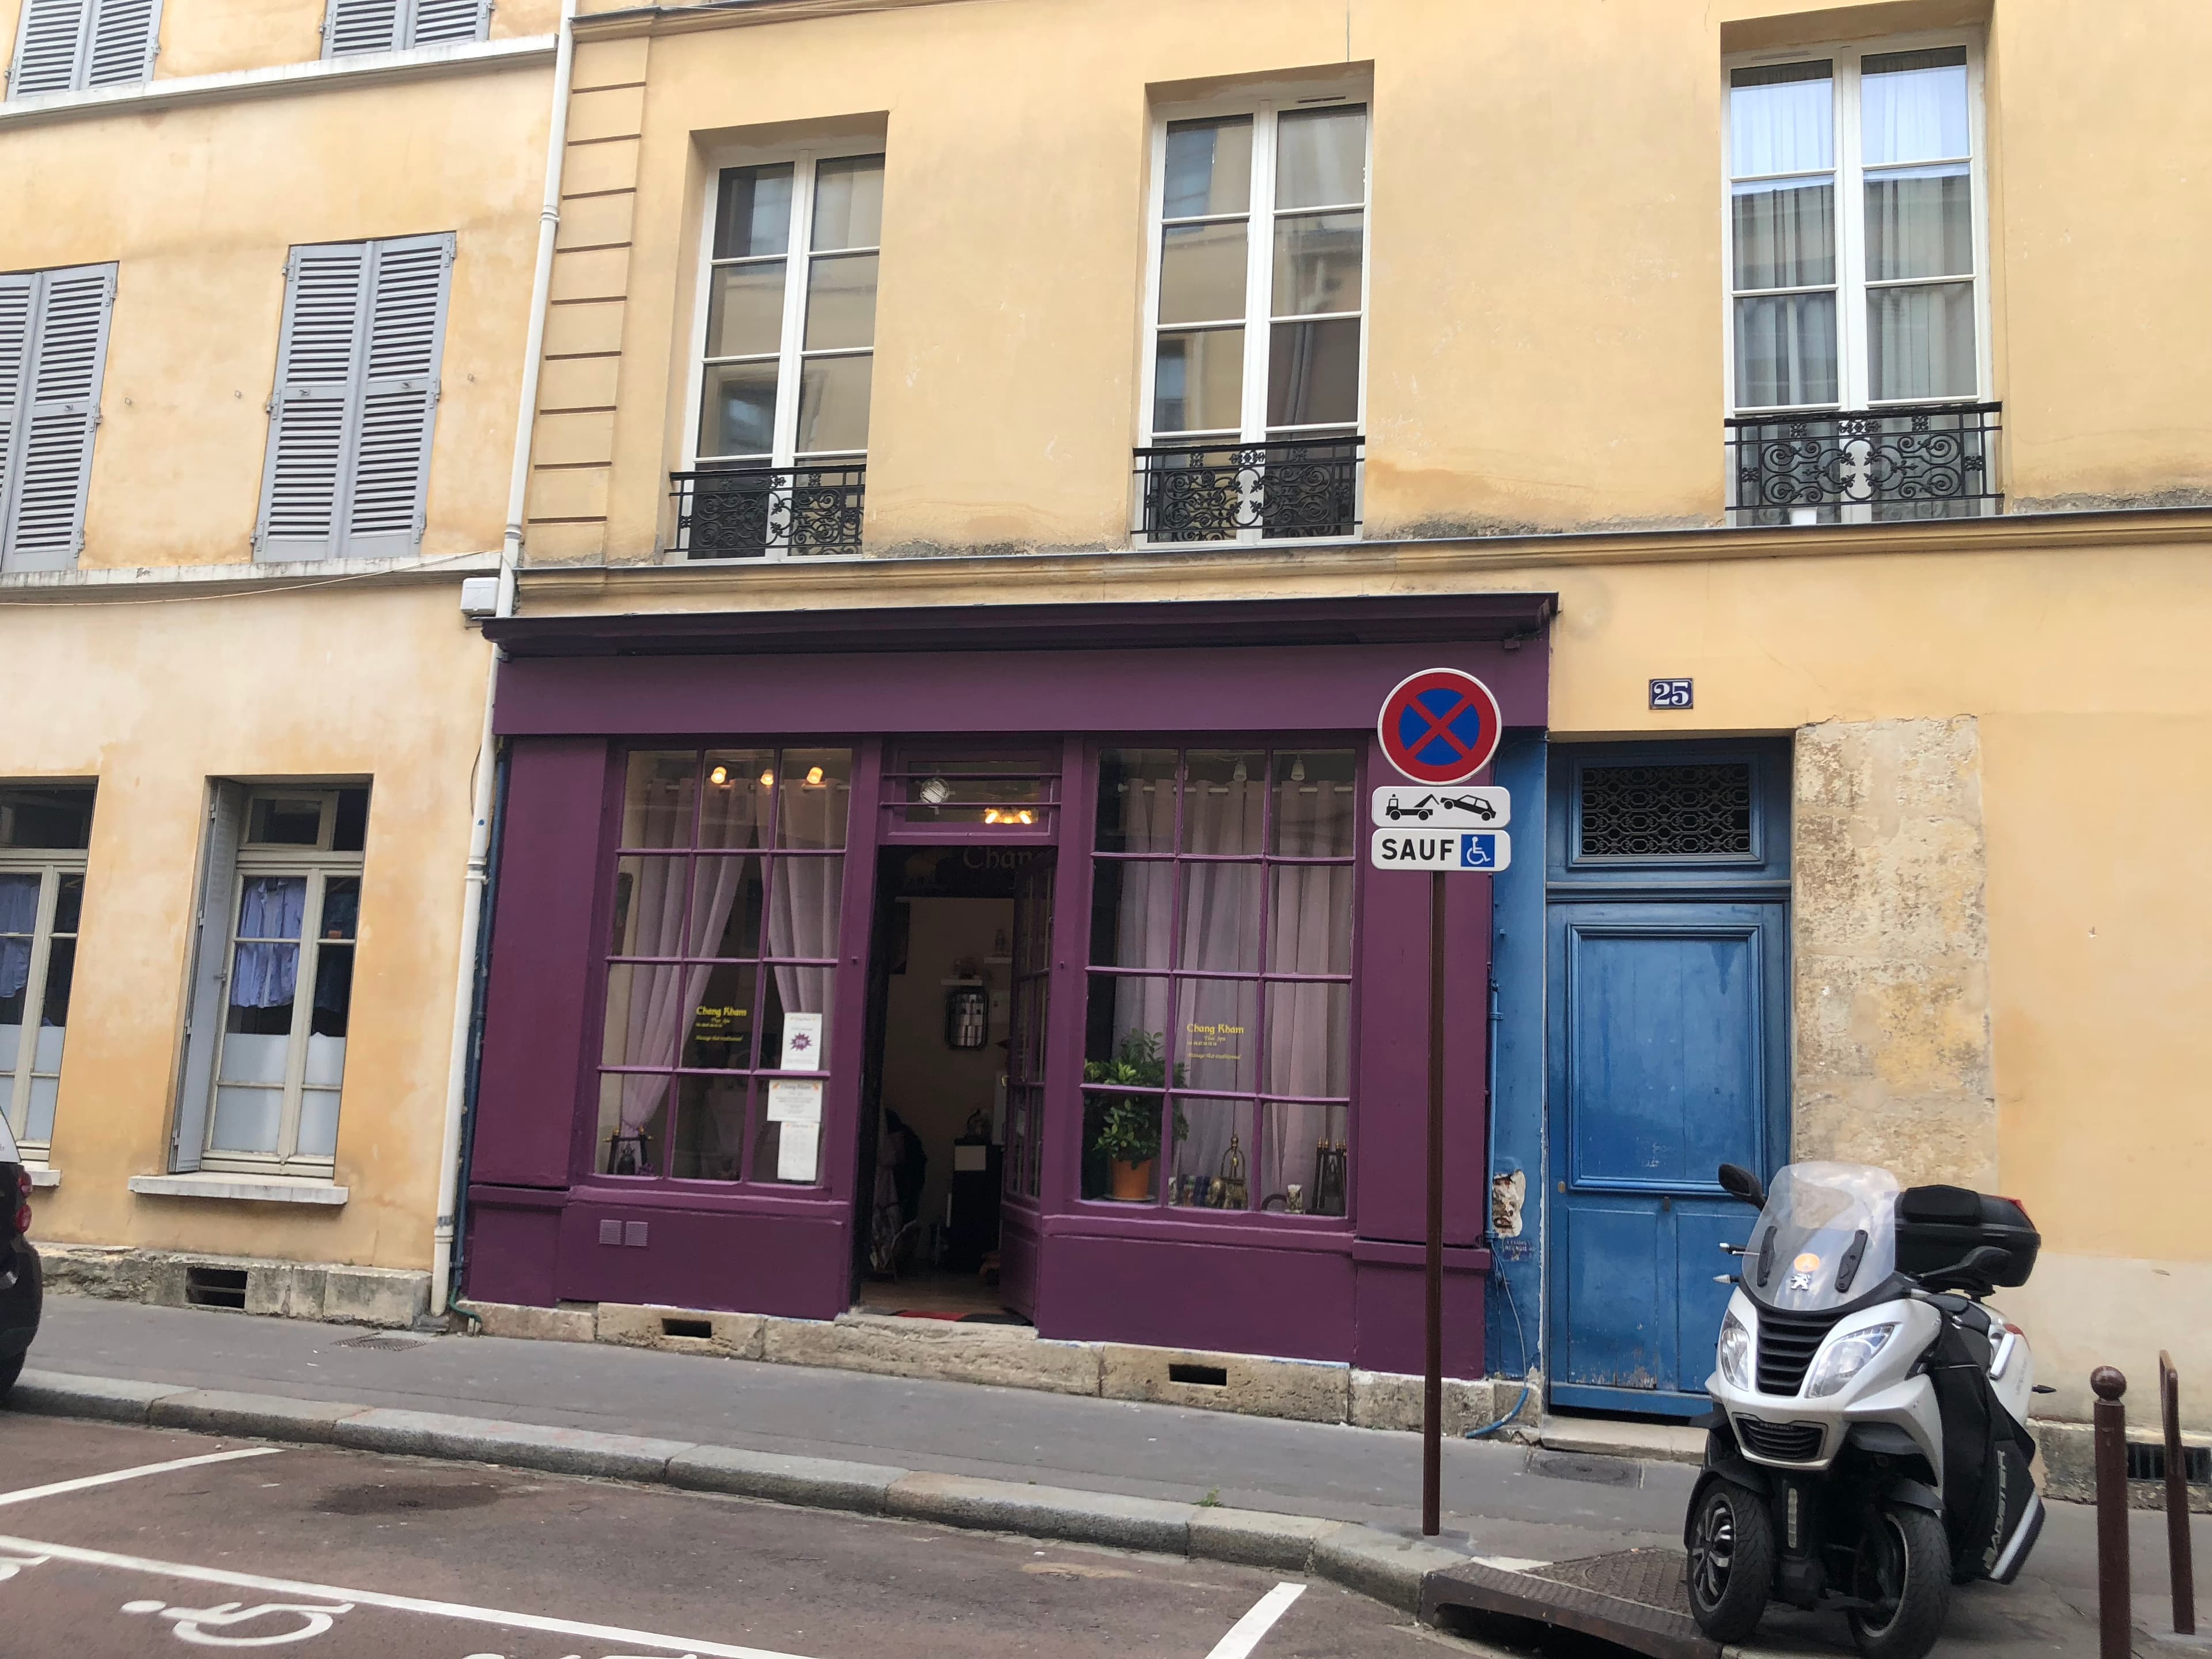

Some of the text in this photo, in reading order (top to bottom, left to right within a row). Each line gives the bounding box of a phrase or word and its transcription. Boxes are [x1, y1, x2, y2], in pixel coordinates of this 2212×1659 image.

[1653, 681, 1690, 705] 25
[1381, 838, 1455, 861] SAUF
[696, 1006, 722, 1018] Chang
[1187, 1023, 1244, 1035] Chang Kham
